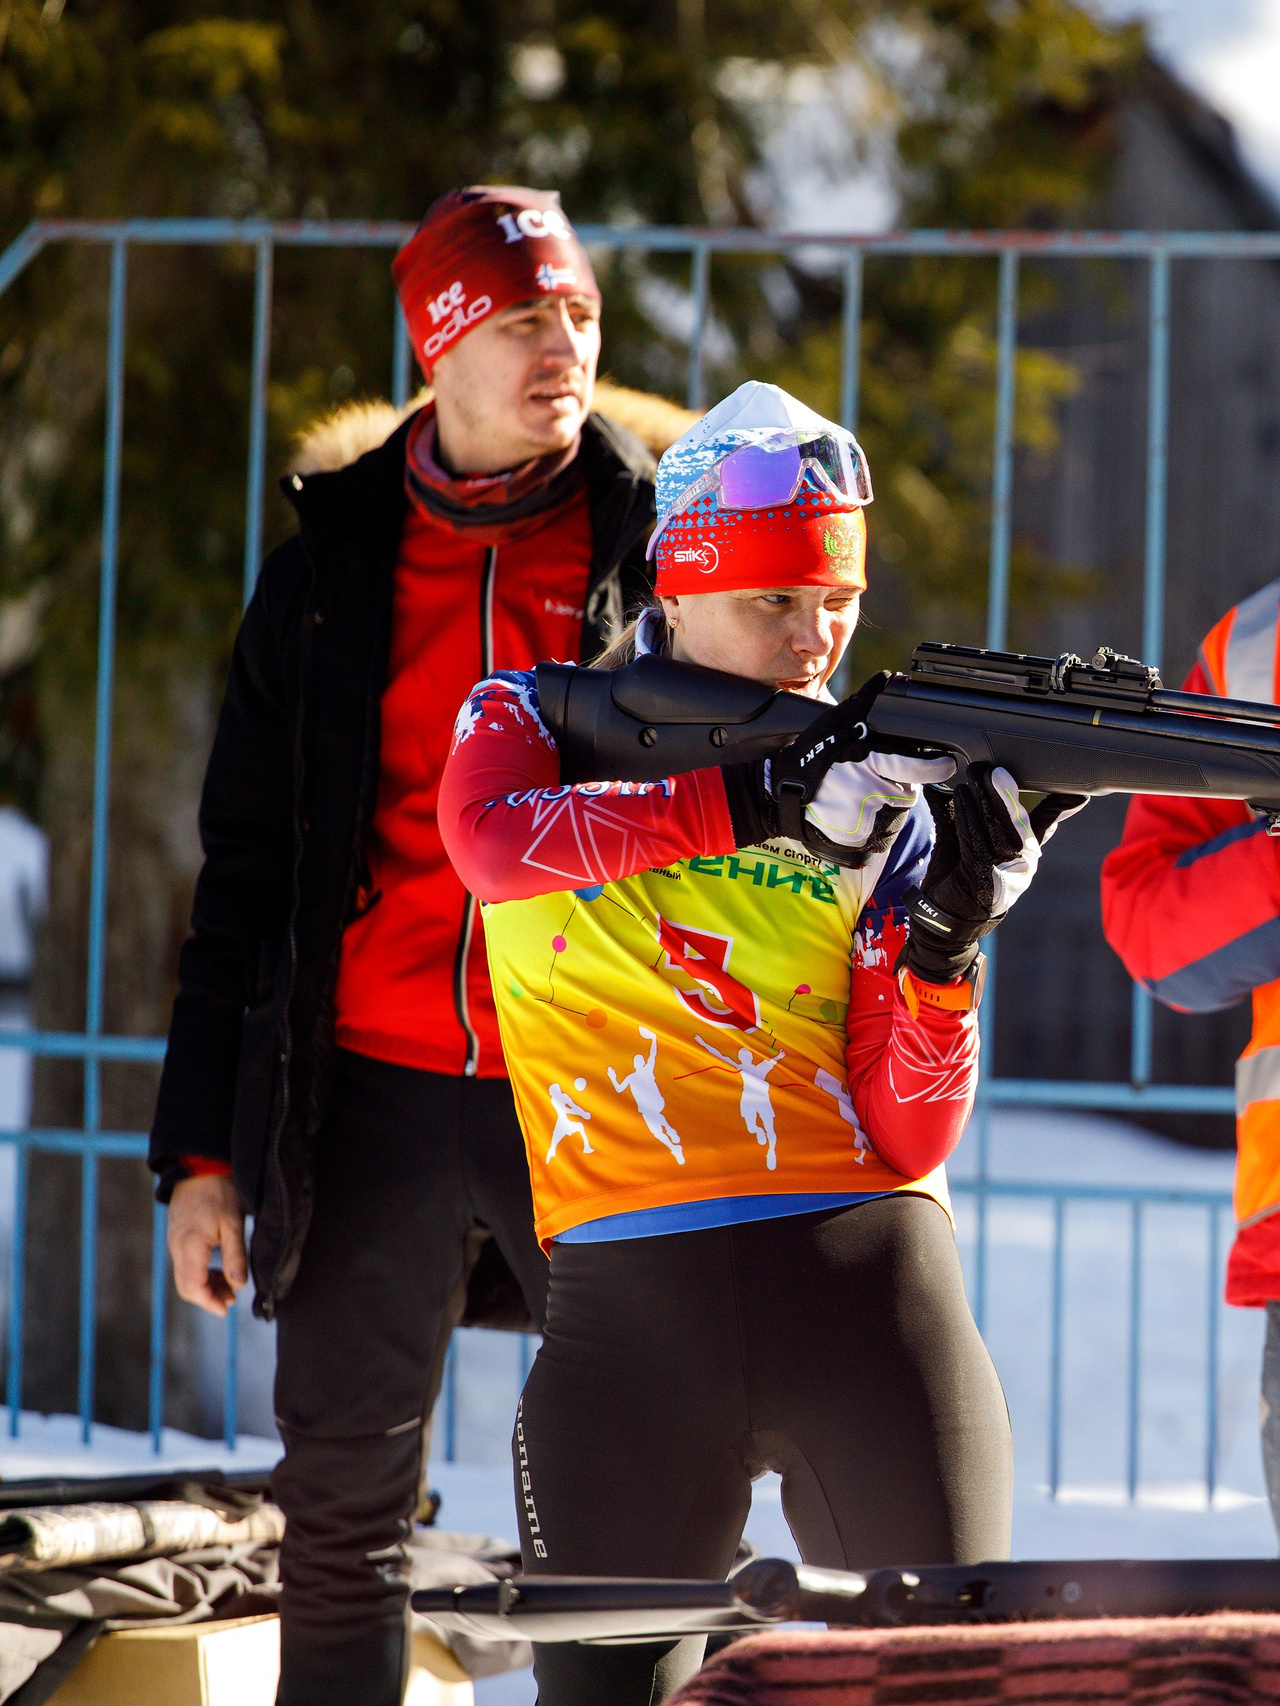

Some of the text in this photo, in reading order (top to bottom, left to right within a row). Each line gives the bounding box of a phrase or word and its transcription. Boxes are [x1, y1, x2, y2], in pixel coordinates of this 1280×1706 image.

[425, 280, 467, 326] ice
[800, 734, 836, 768] LEKI
[917, 899, 939, 918] LEKI
